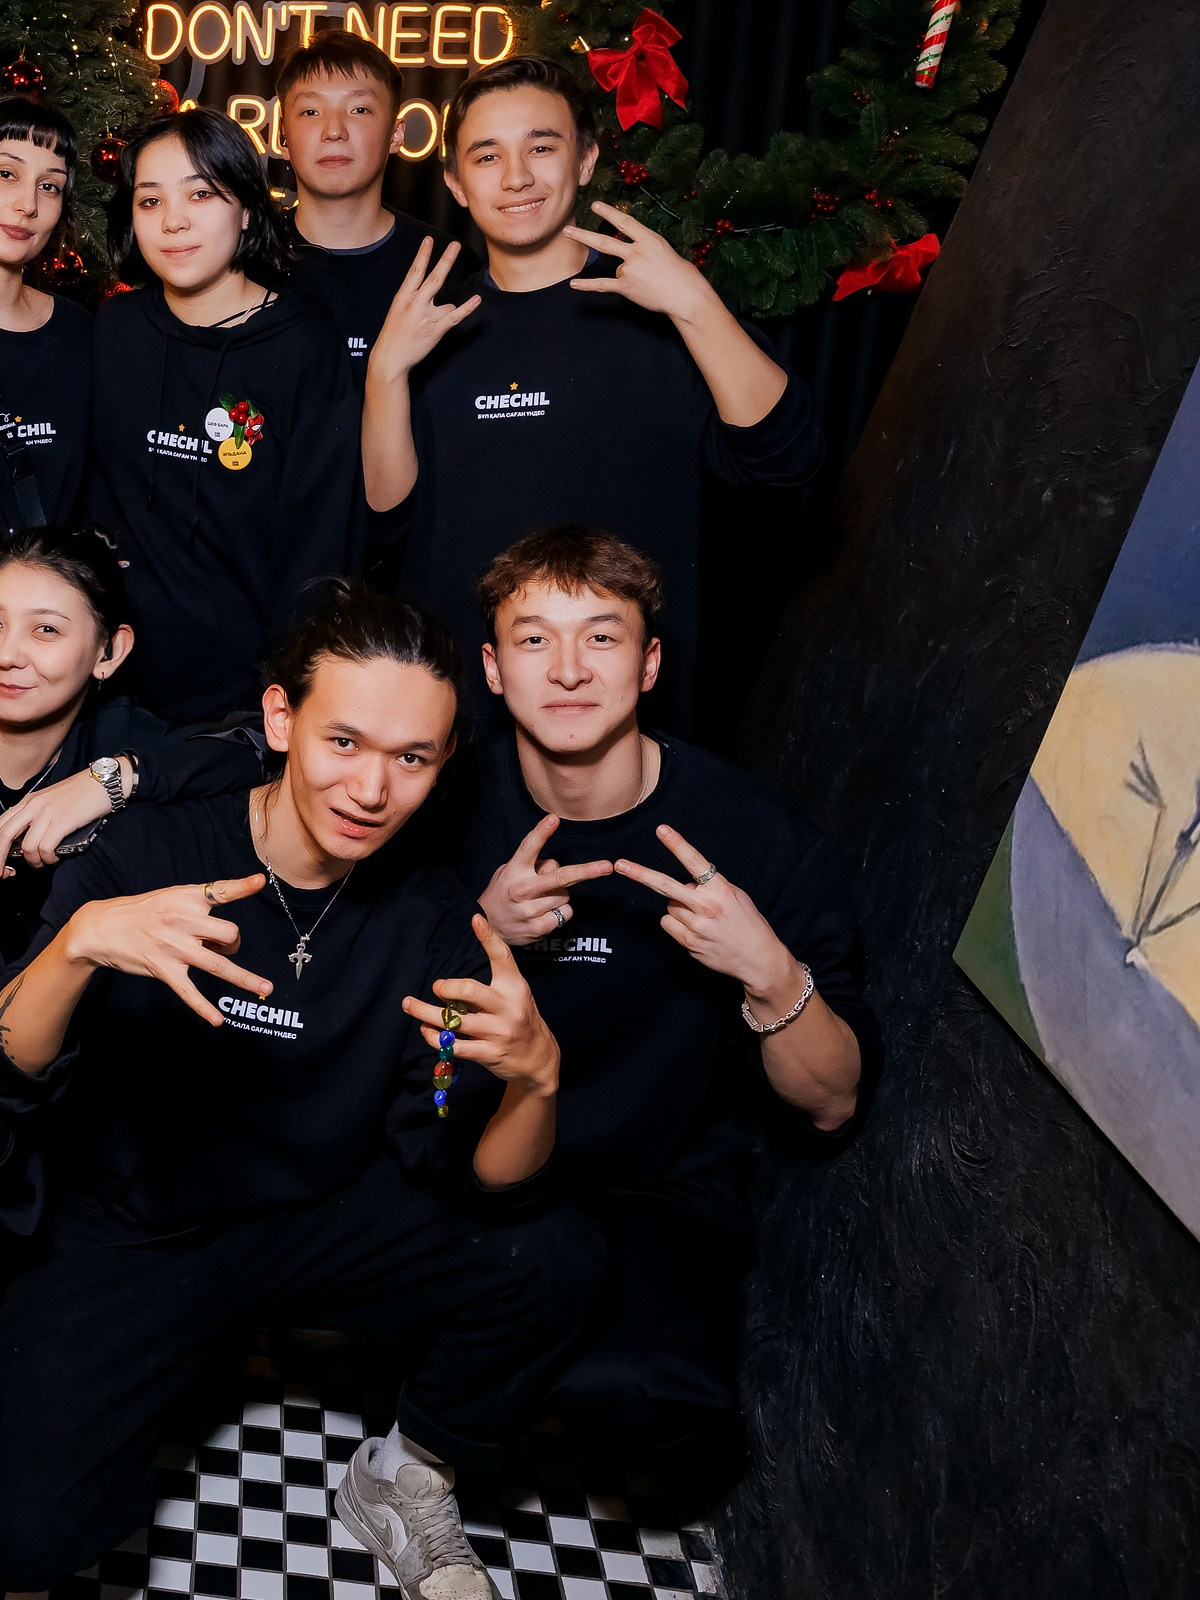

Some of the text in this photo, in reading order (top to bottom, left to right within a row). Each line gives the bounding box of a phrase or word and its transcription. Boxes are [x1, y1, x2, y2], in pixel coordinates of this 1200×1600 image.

[146, 4, 513, 65] DON'T NEED
[475, 391, 550, 410] CHECHIL
[146, 429, 213, 454] CHECHL
[218, 996, 304, 1029] CHECHIL
